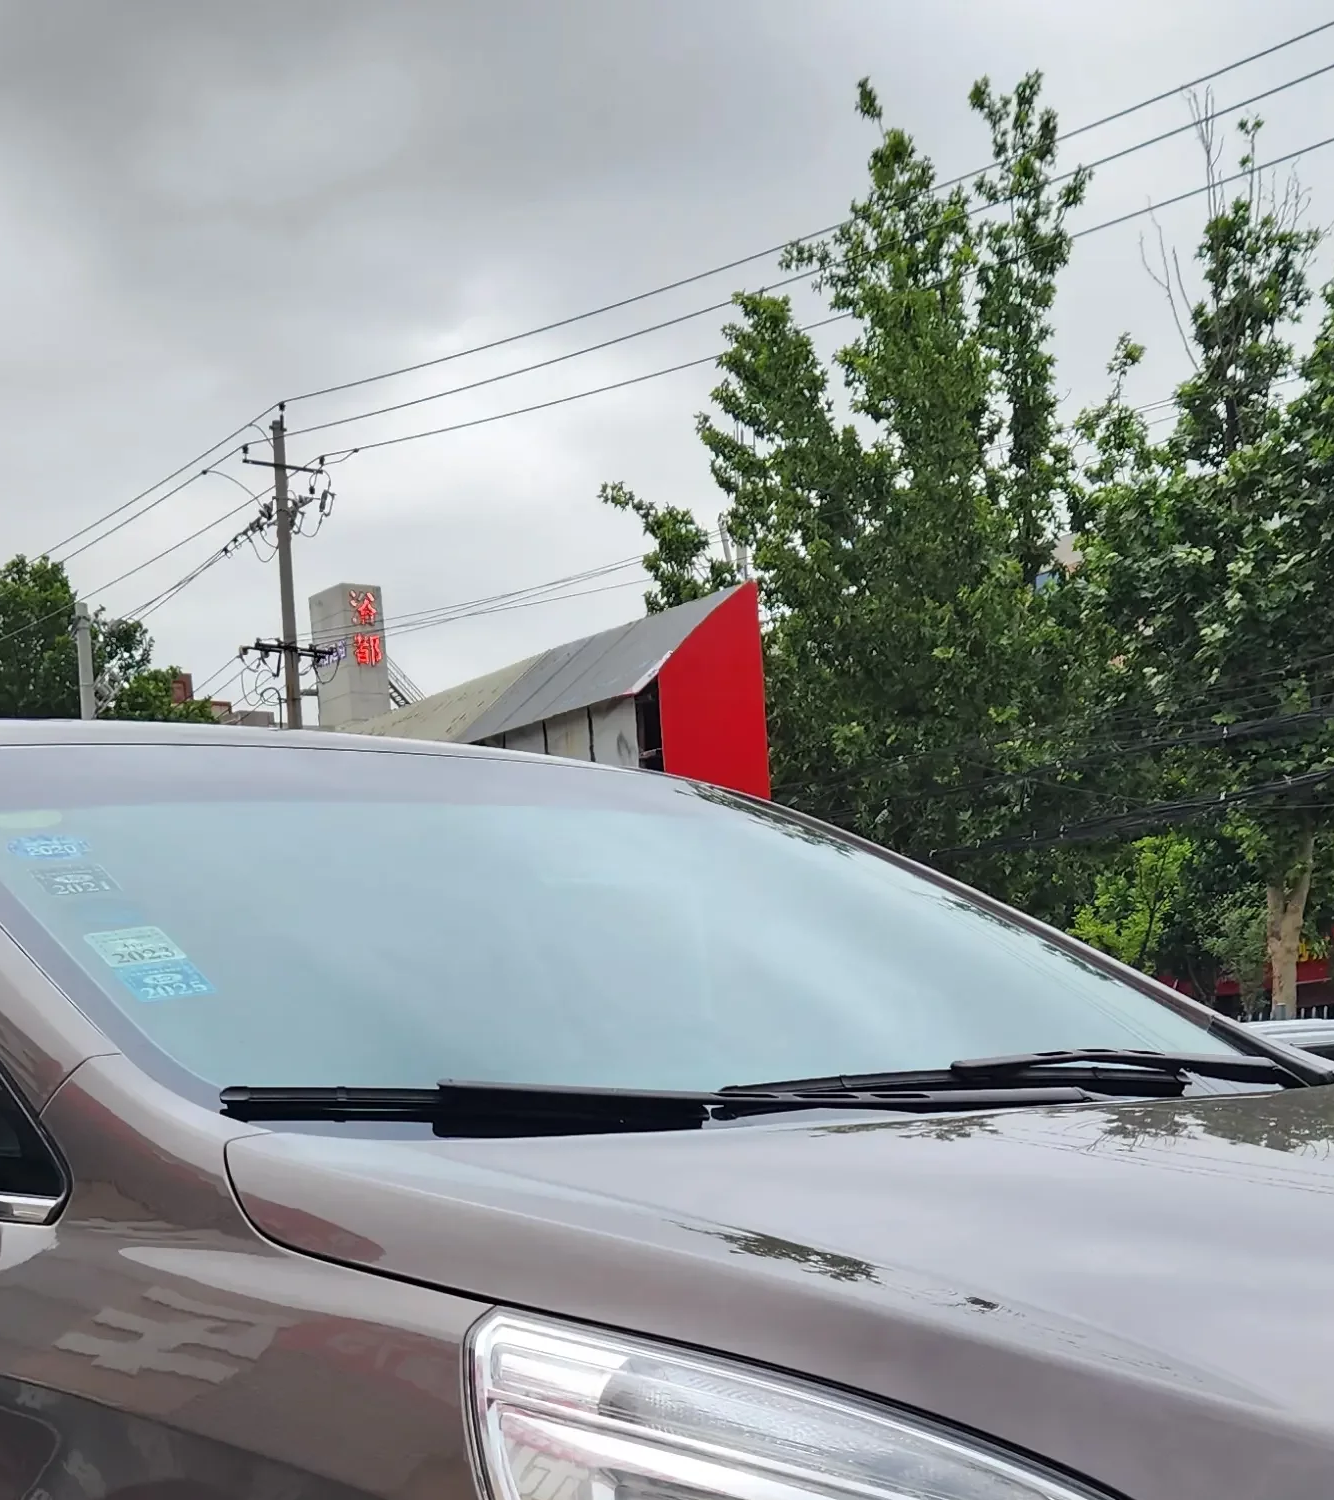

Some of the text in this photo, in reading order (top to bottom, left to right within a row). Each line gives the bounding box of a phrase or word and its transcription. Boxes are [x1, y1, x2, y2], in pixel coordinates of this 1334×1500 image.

[349, 590, 382, 666] 浴都
[51, 881, 111, 896] 2021
[111, 946, 176, 964] 2023
[140, 980, 208, 1000] 2025
